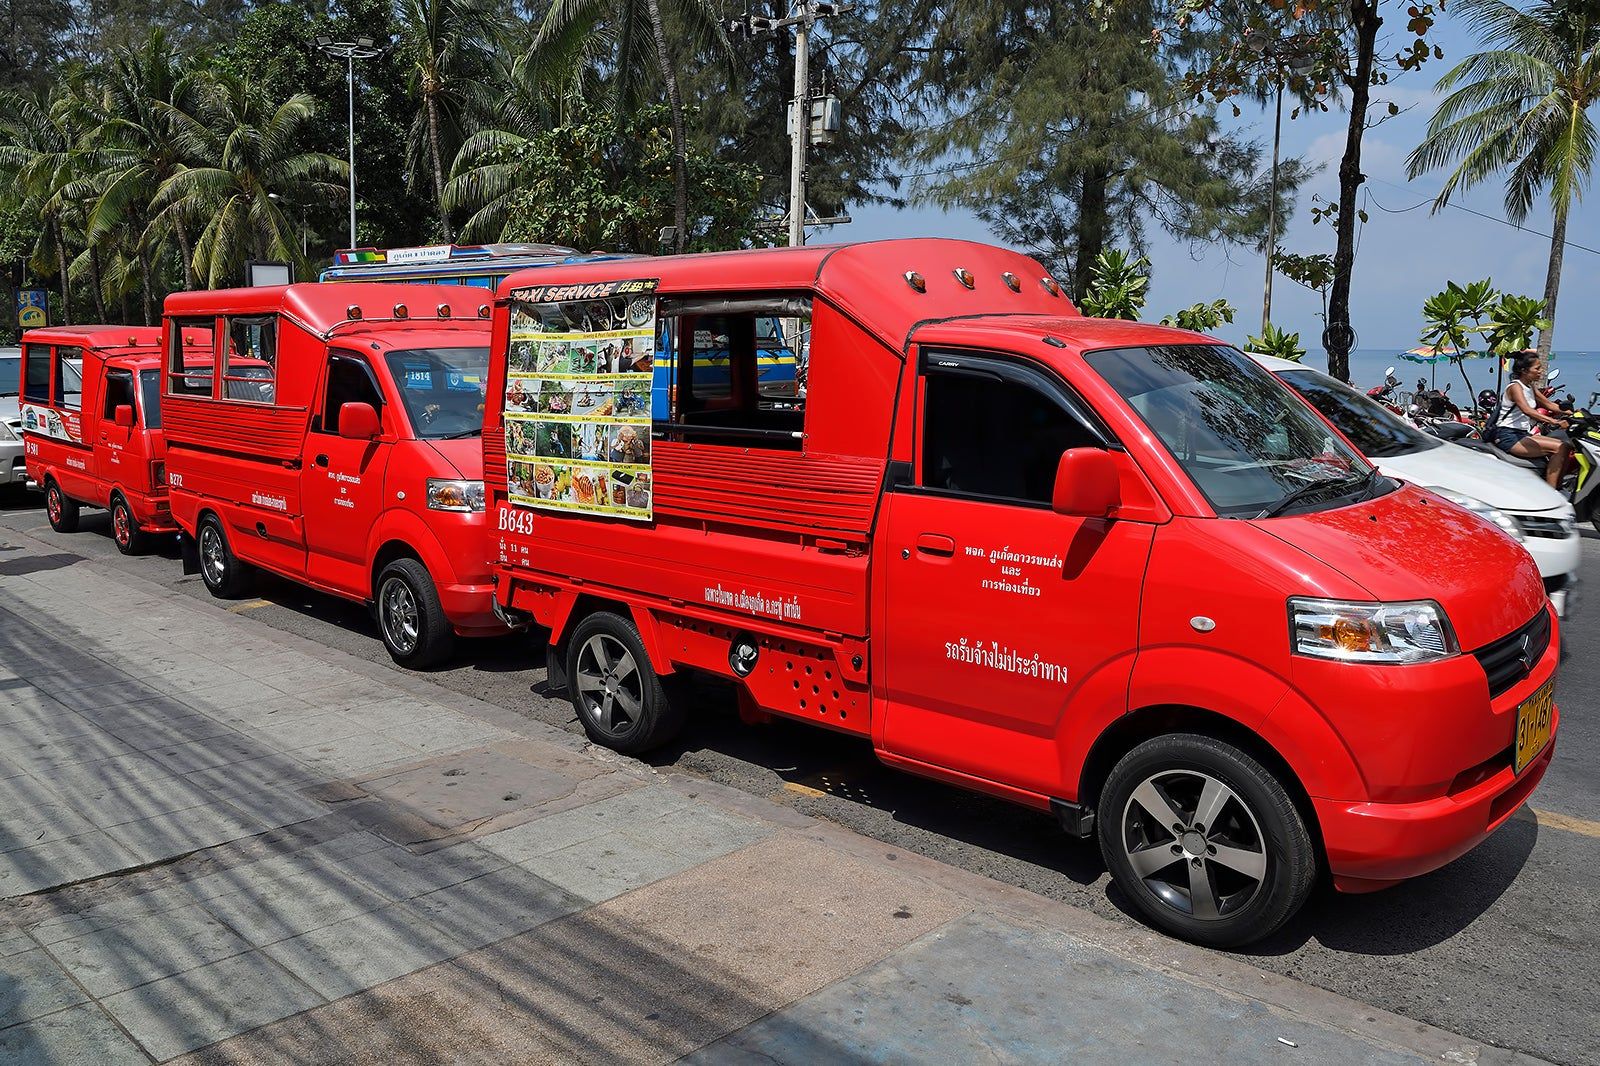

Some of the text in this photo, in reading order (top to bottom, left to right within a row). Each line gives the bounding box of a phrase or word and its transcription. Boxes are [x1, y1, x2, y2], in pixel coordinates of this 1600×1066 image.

[513, 282, 616, 303] TAXI SERVICE
[498, 507, 534, 535] B643
[510, 543, 518, 552] 11
[965, 545, 1063, 569] หจก. ภูเก็ตถาวรขนส่ง
[1001, 565, 1021, 576] และ
[981, 578, 1041, 597] การท่องเที่ยว
[944, 637, 1068, 684] รถรับจ้างไม่ประจำทาง
